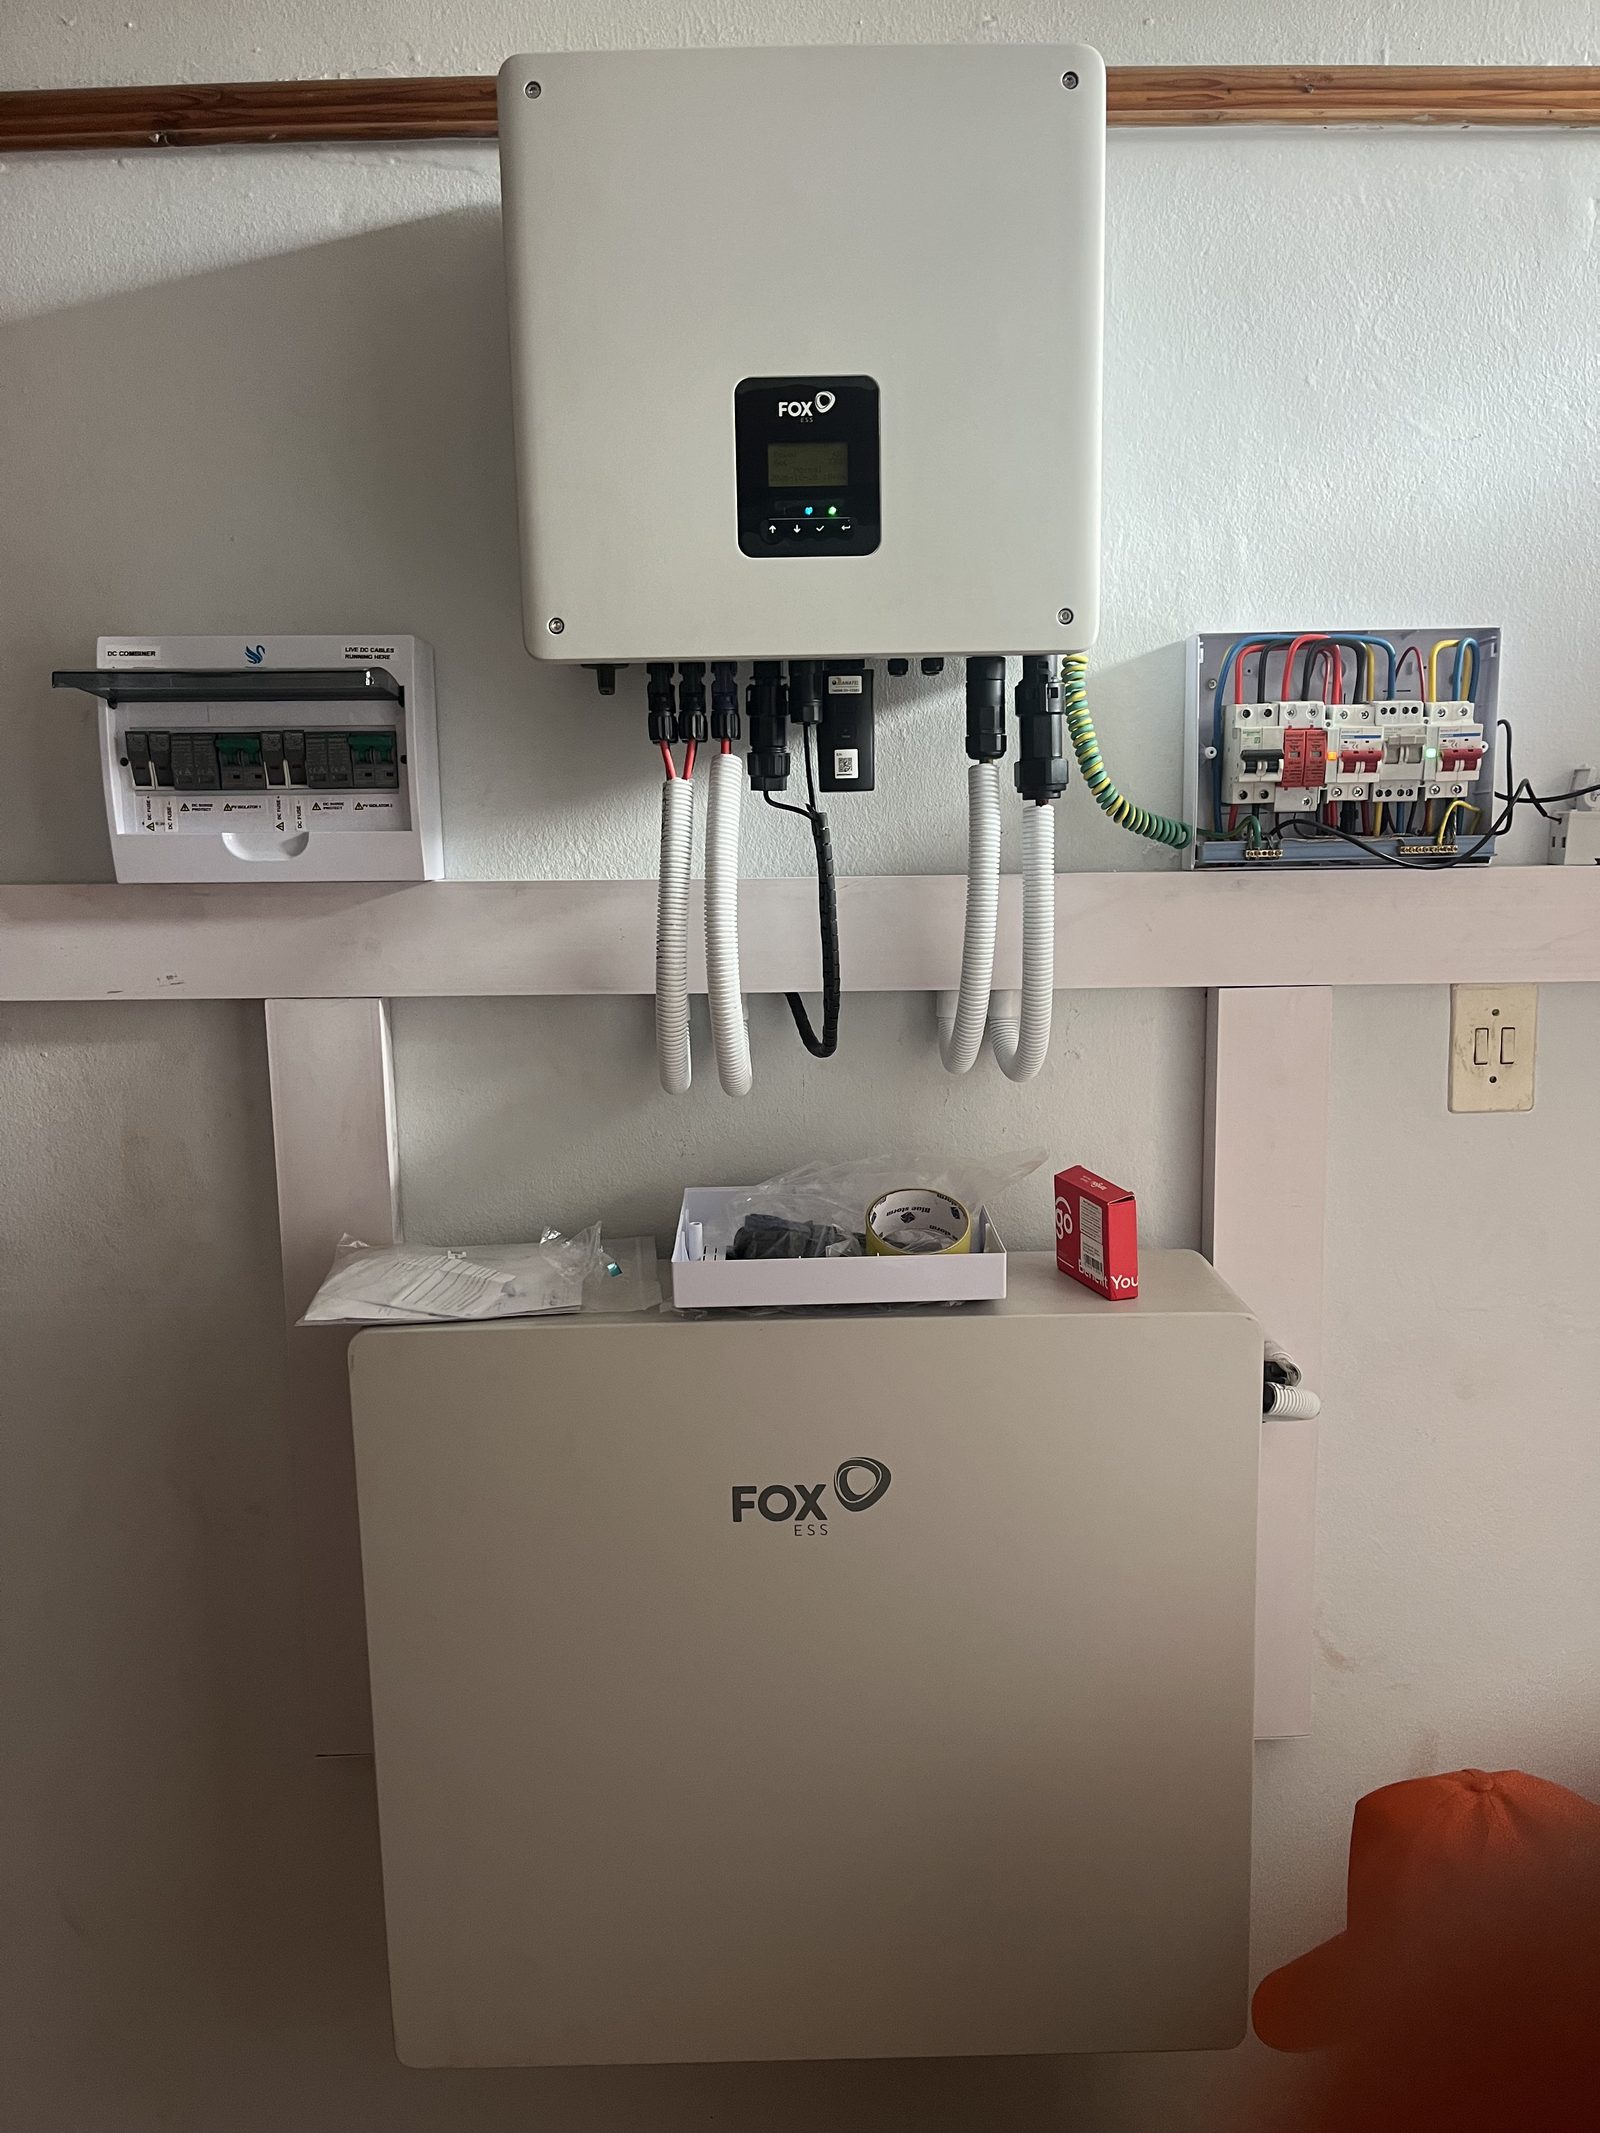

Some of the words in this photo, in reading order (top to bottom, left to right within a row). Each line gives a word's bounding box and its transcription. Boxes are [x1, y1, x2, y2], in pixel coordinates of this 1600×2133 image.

[778, 401, 813, 417] FOX
[167, 822, 173, 830] DC
[297, 820, 303, 829] DC
[886, 1206, 910, 1217] storm
[911, 1206, 931, 1214] Blue
[1110, 1274, 1139, 1290] You
[732, 1483, 828, 1523] FOX
[794, 1523, 828, 1537] ESS
